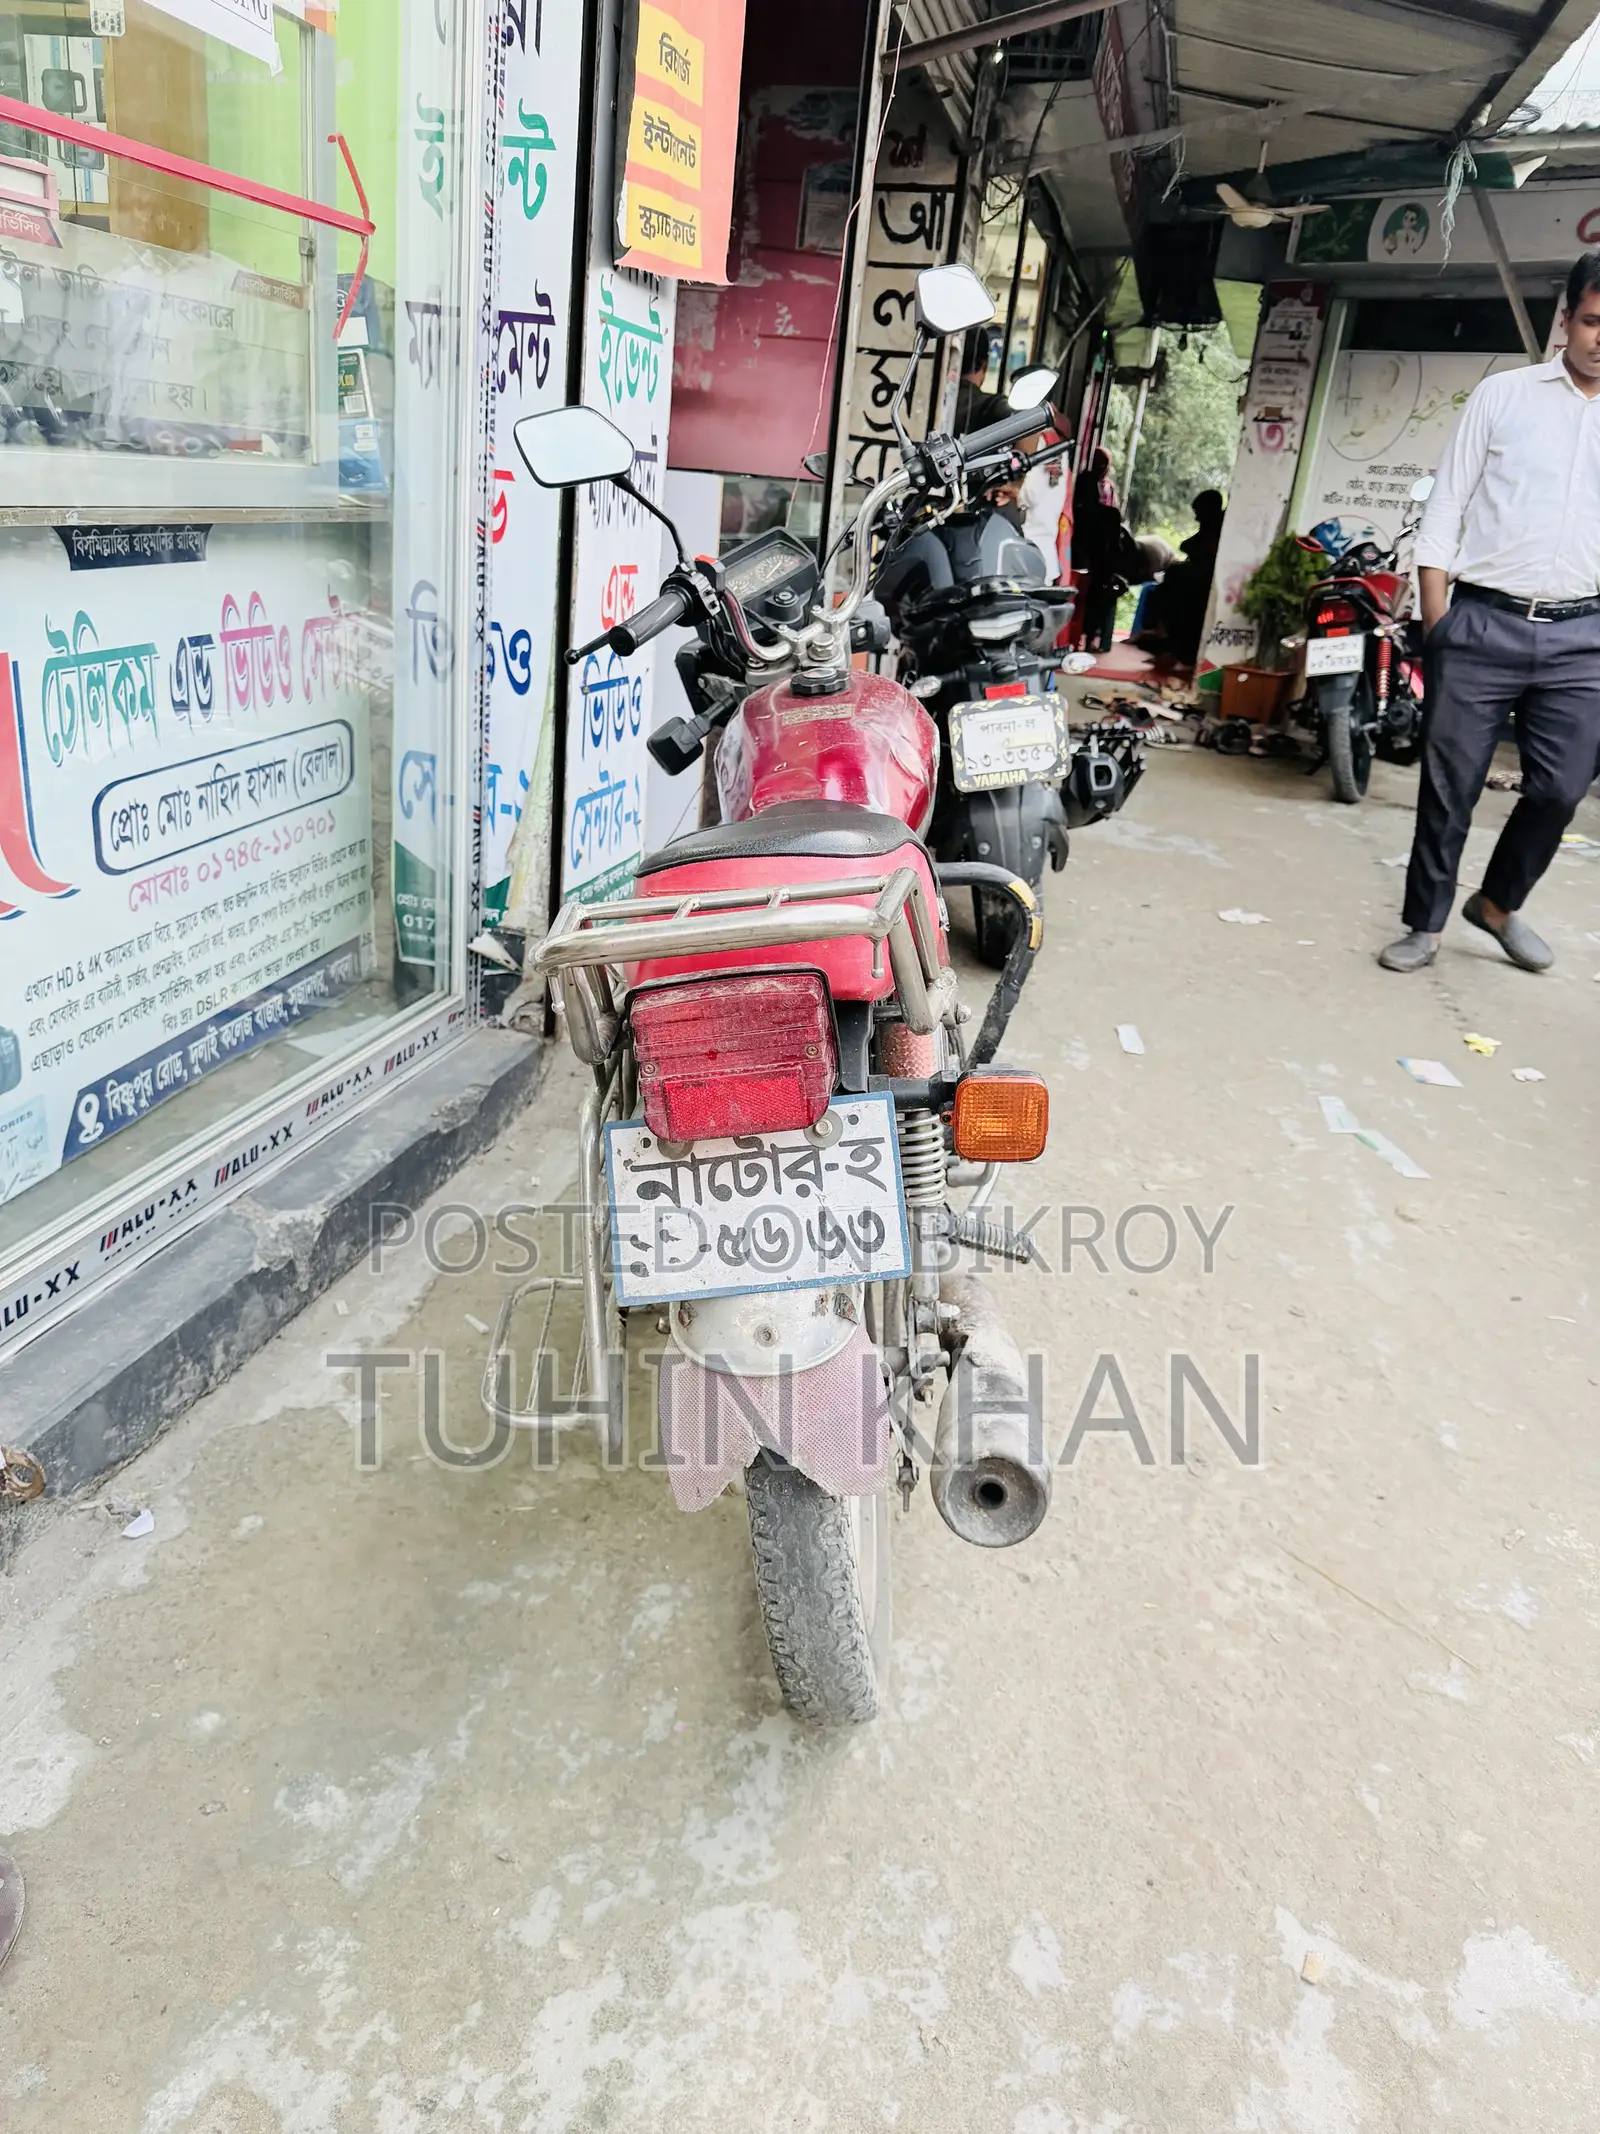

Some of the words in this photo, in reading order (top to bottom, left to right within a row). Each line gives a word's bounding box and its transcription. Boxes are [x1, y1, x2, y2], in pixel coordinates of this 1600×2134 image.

[658, 31, 691, 86] রিচার্জ
[643, 111, 697, 168] ইন্টারনেট
[598, 273, 663, 417] ইভেন্ট
[42, 609, 160, 767] টেলিকম
[219, 590, 293, 721] ভিডিও
[581, 651, 642, 761] ভিডিও
[110, 798, 150, 852] প্রোঃ
[157, 784, 192, 836] মোঃ
[195, 762, 242, 822] নাহিদ
[245, 757, 288, 808] হাসান
[972, 769, 1029, 788] YAMAHA
[129, 865, 189, 913] মোবাঃ
[56, 966, 74, 992] HD
[77, 961, 85, 982] &
[88, 952, 103, 975] 4K
[196, 987, 229, 1017] DSLR
[31, 1038, 75, 1072] এছাড়াও
[118, 995, 157, 1031] মোবাইল
[231, 1122, 294, 1176] ALU-XX
[630, 1136, 888, 1209] নাটোর-হ
[121, 1178, 198, 1240] ALU-XX
[0, 1260, 81, 1331] LU-XX
